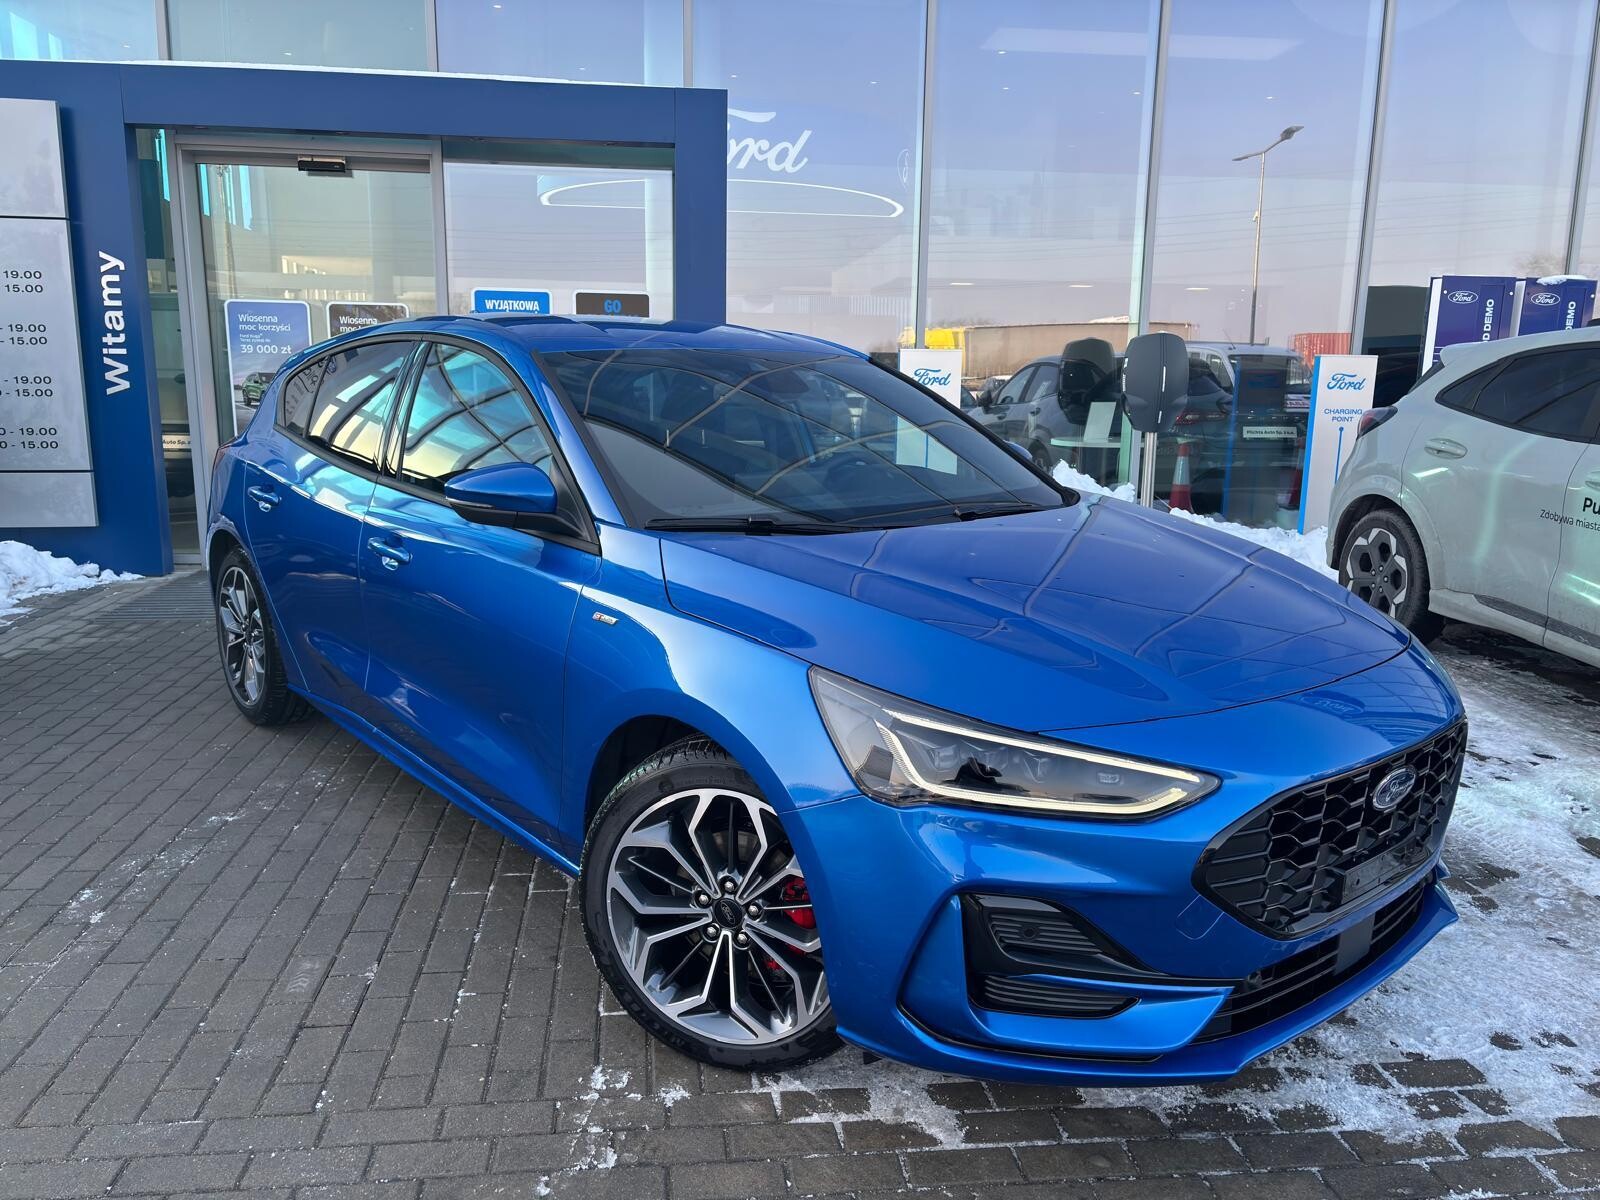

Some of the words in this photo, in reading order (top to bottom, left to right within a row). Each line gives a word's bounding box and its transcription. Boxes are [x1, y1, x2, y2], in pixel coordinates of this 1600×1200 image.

[728, 108, 813, 174] rd
[3, 270, 42, 280] 19.00
[5, 284, 44, 293] 15.00
[604, 299, 622, 313] GO
[238, 313, 278, 323] Wiosenna
[339, 315, 378, 325] Wiosenna
[1484, 299, 1495, 332] DEMO
[8, 323, 47, 333] 19.00
[98, 250, 131, 396] Witamy
[258, 323, 291, 333] korzyści
[9, 336, 48, 345] 15.00
[240, 344, 254, 354] 39
[256, 345, 278, 354] 000
[281, 345, 292, 354] zł
[13, 375, 52, 385] 19.00
[914, 368, 952, 386] Ford
[1327, 373, 1366, 391] Ford
[15, 388, 54, 397] 15.00
[19, 427, 58, 436] 19.00
[21, 441, 59, 449] 15.00
[1540, 509, 1574, 526] Zdobywa
